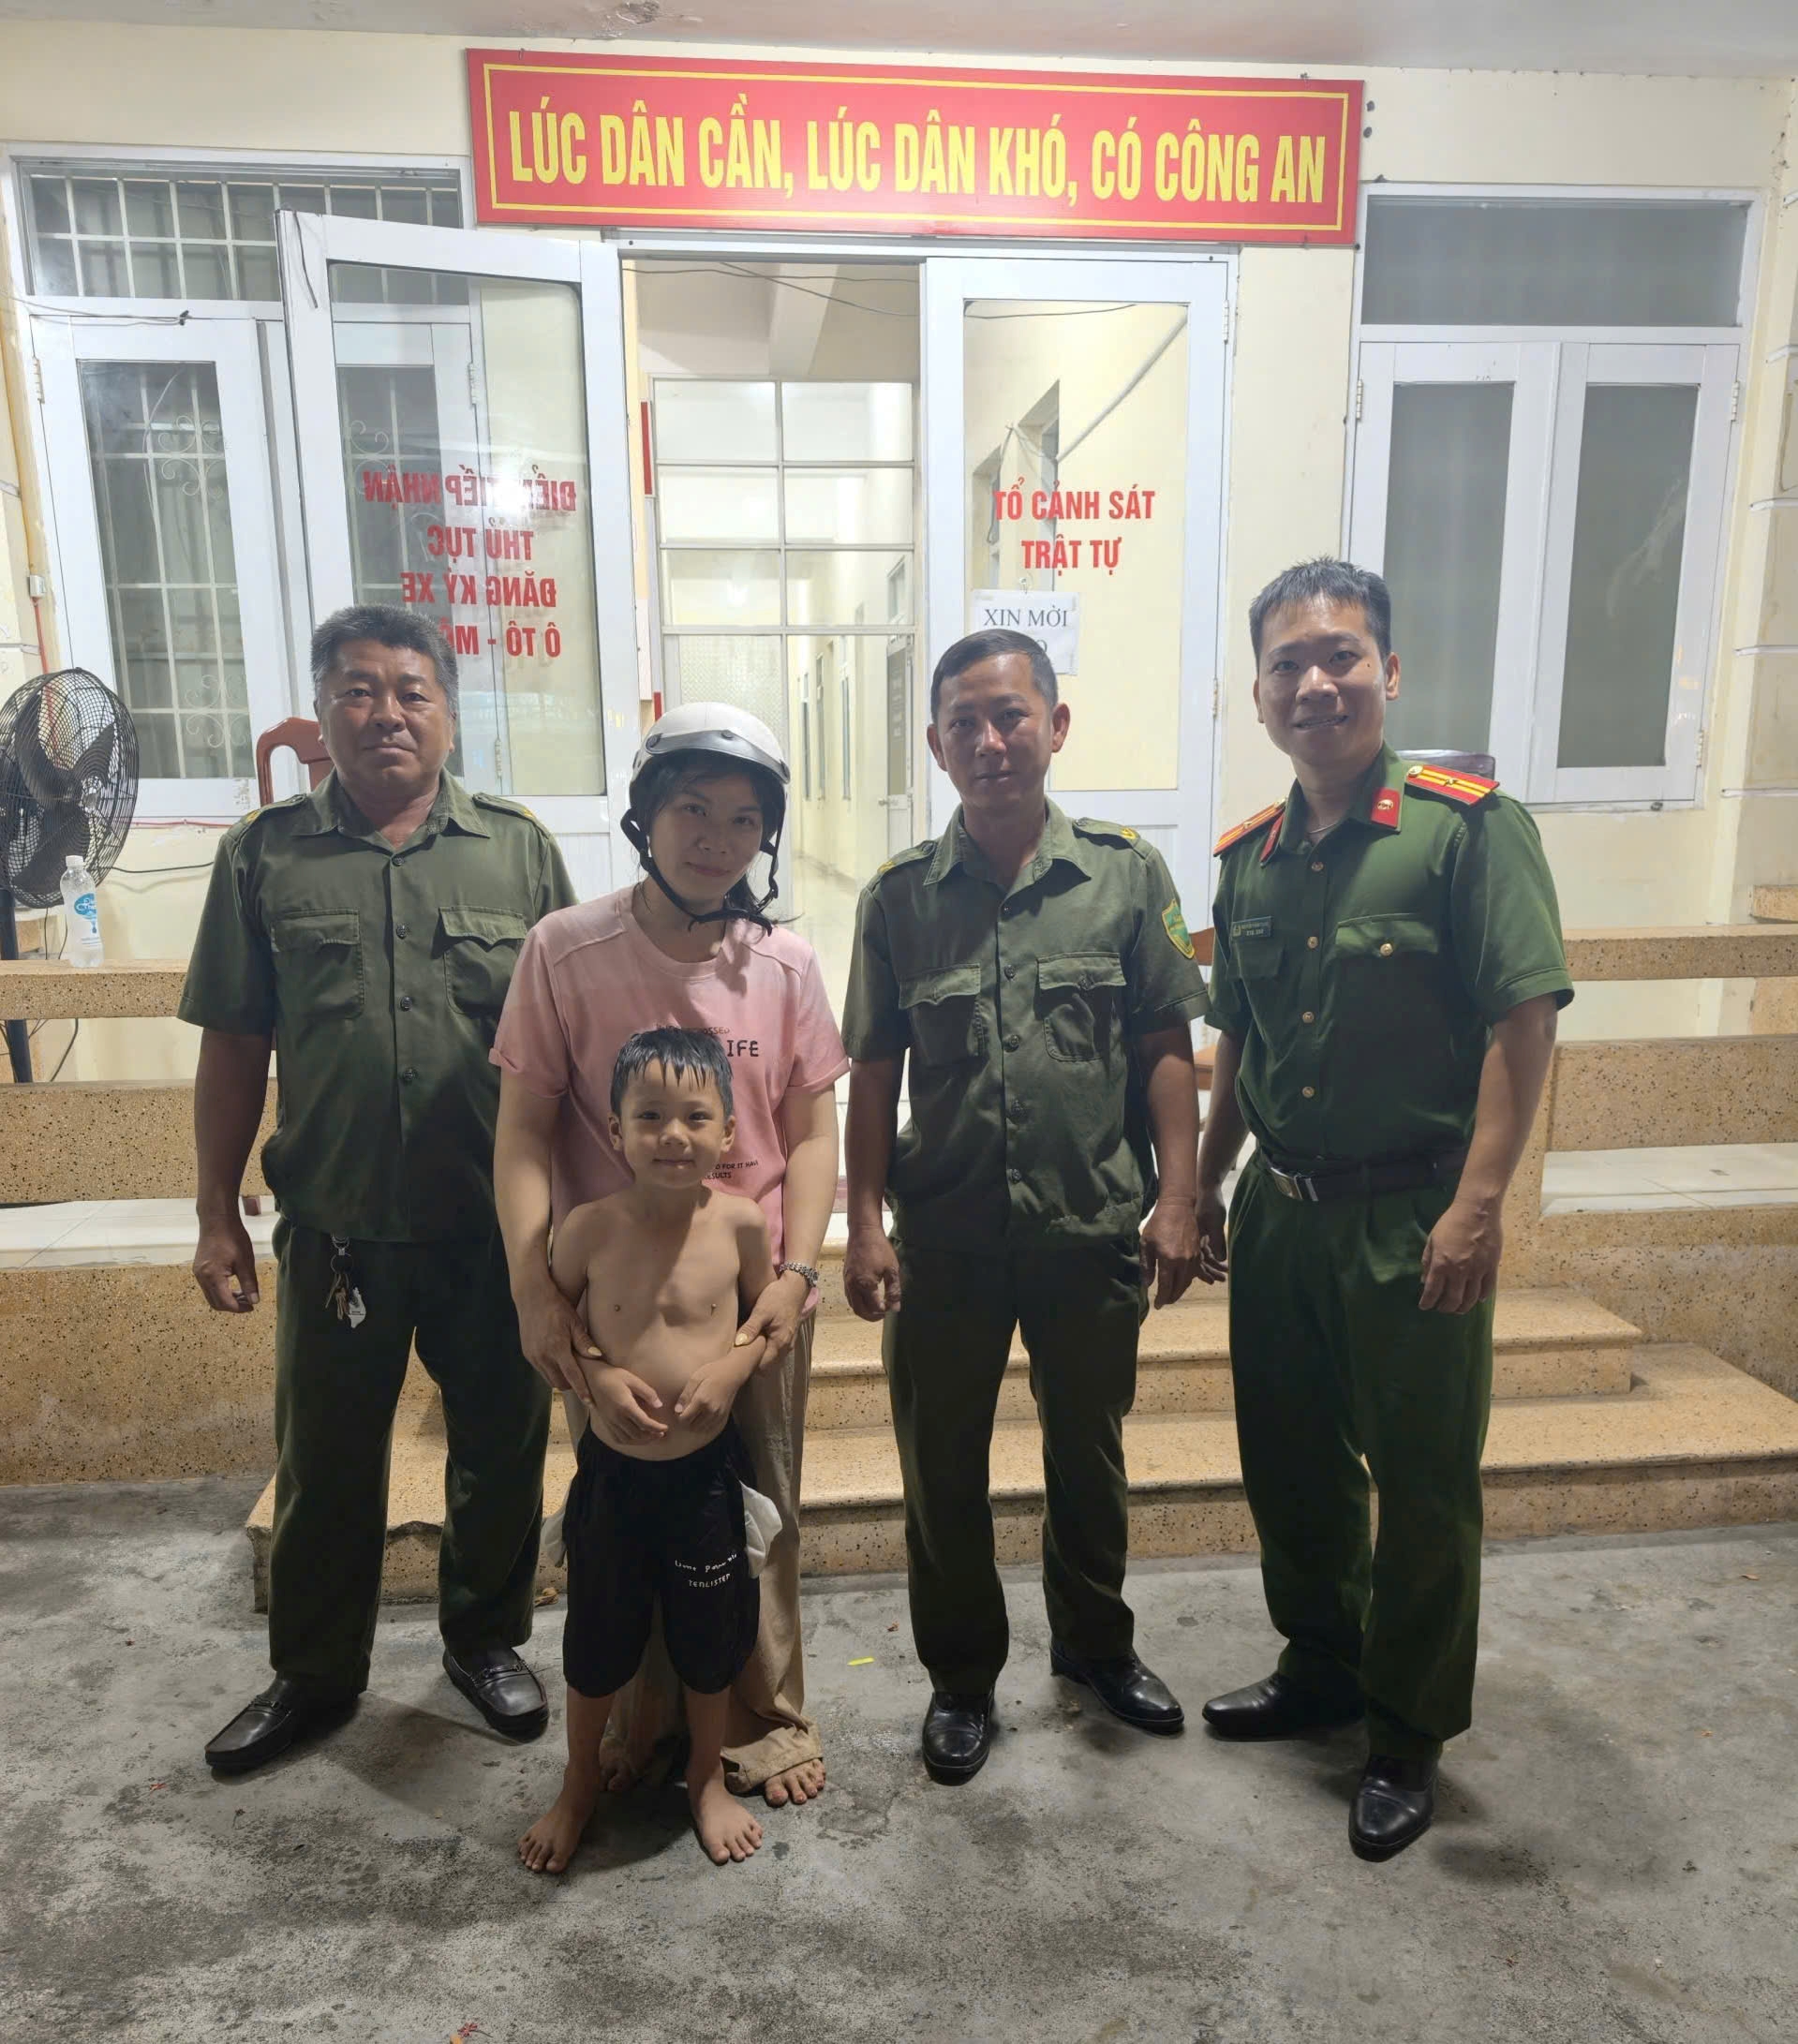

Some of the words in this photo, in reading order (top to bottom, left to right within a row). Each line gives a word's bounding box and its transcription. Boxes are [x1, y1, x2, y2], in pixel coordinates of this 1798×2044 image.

[509, 96, 587, 185] LÚC
[600, 99, 685, 186] DÂN
[698, 93, 794, 199] CẦN,
[807, 106, 881, 192] LÚC
[894, 109, 975, 195] DÂN
[988, 113, 1077, 207] KHÓ,
[1092, 116, 1142, 200] CÓ
[1154, 118, 1260, 202] CÔNG
[1270, 134, 1326, 203] AN
[993, 476, 1025, 521] TỔ
[1031, 479, 1100, 520] CẢNH
[1108, 483, 1155, 519] SÁT
[1020, 533, 1082, 577] TRẬT
[1090, 536, 1122, 576] TỰ
[984, 608, 1021, 627] XIN
[1027, 604, 1068, 628] MỜI
[726, 1039, 760, 1058] IFE
[704, 1171, 732, 1180] ESULTS
